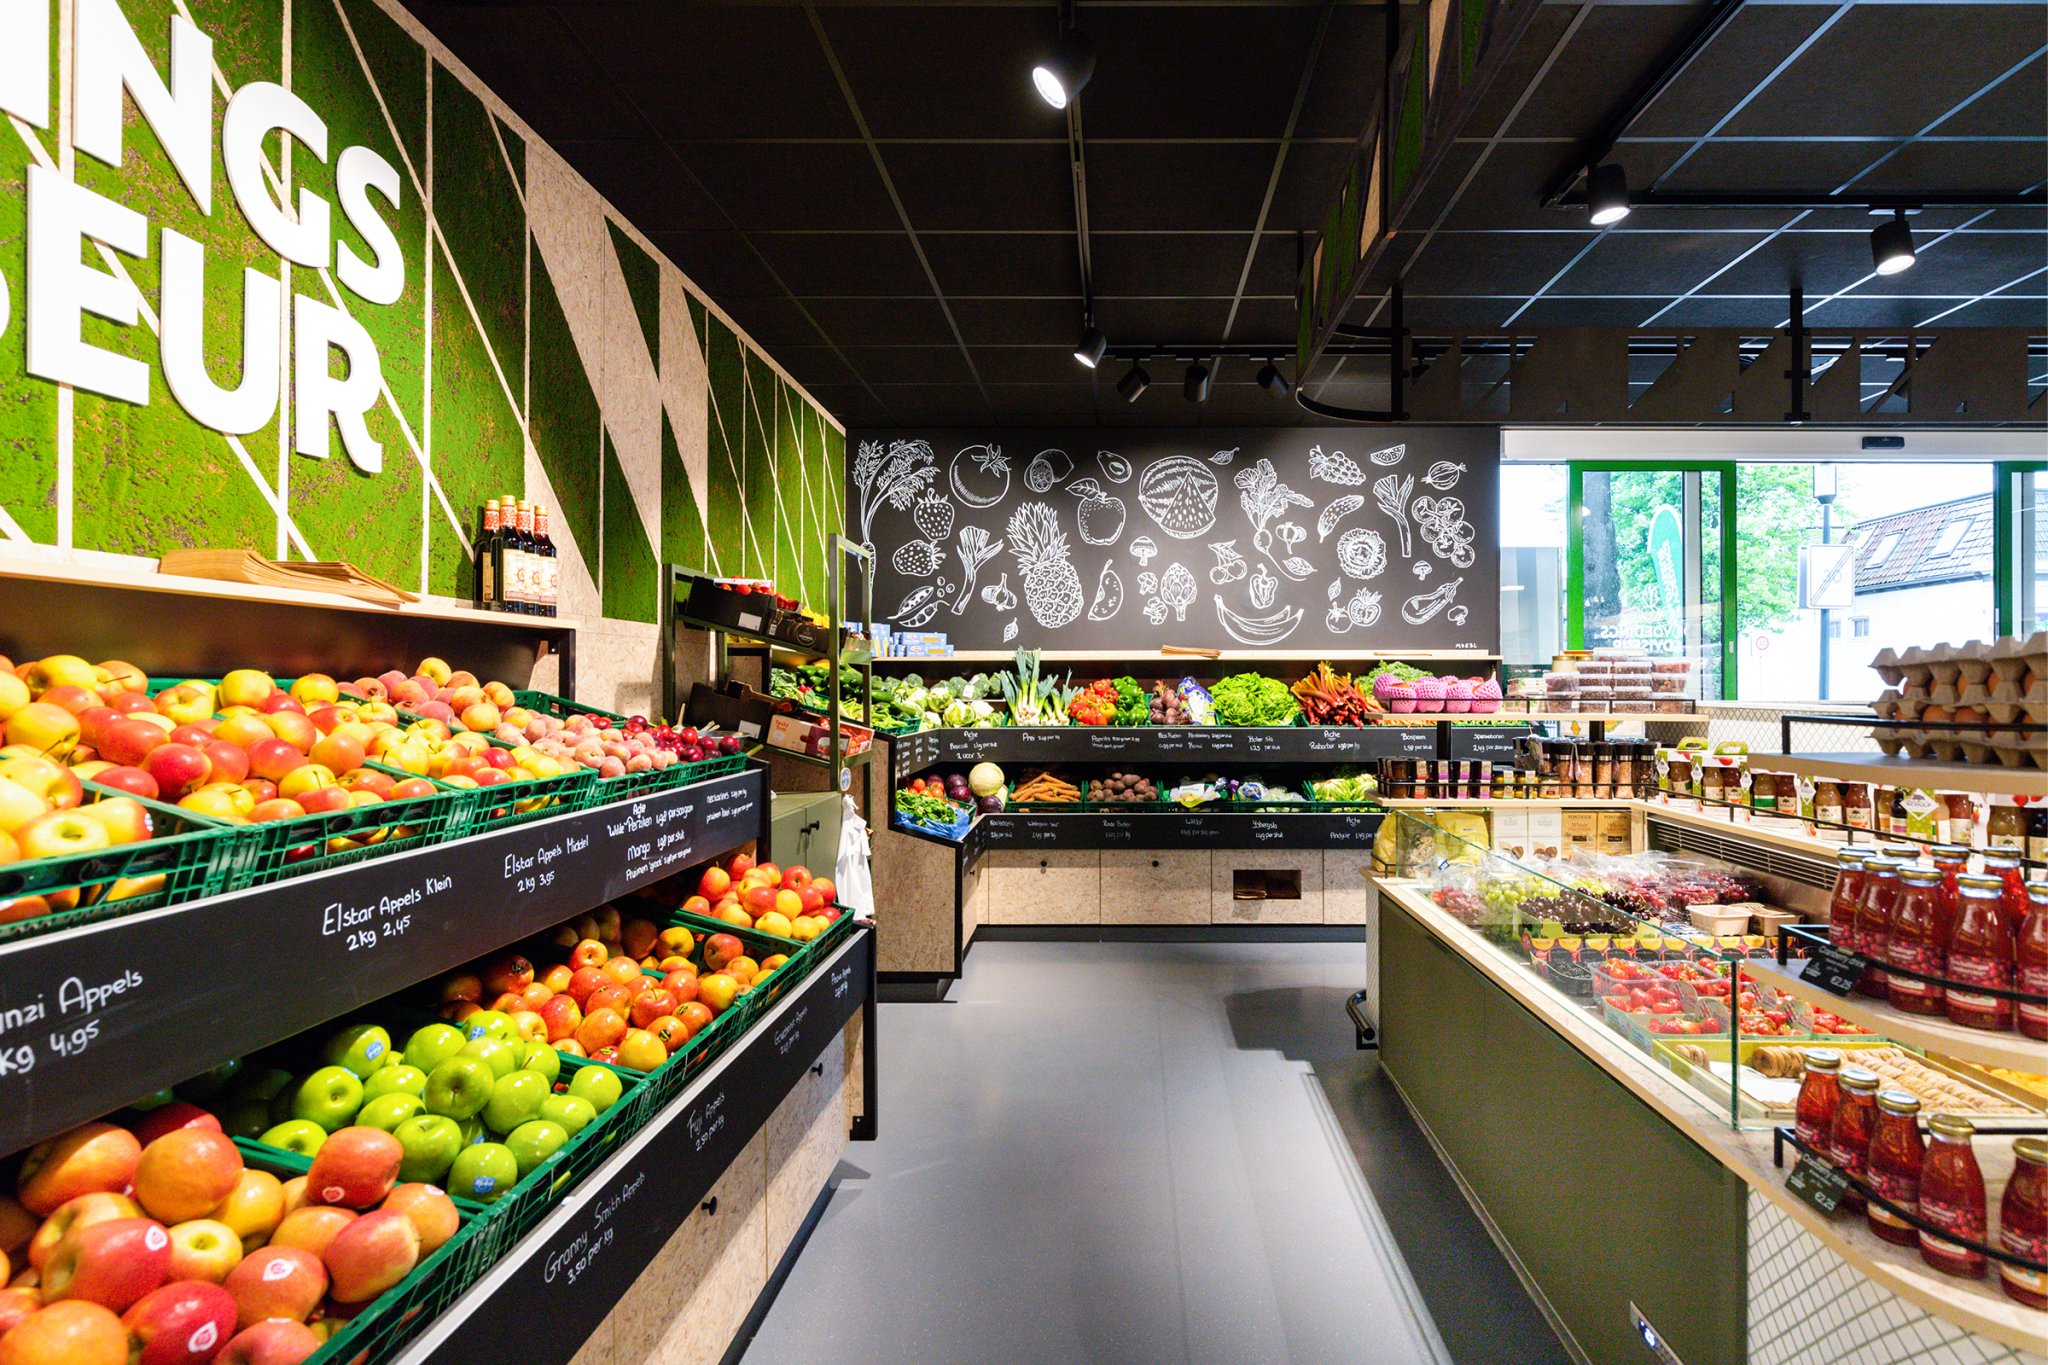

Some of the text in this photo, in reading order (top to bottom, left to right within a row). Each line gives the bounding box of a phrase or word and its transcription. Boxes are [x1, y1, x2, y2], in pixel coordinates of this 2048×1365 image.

[0, 164, 382, 474] EUR
[1022, 732, 1036, 742] Prei
[504, 834, 589, 879] Elstar Appels Middel
[627, 842, 651, 861] Mango
[322, 875, 453, 936] Elstar Appels Klein
[383, 914, 412, 937] 2,45
[58, 969, 144, 1015] Appels
[686, 1091, 726, 1140] Fuji Appels
[544, 1171, 646, 1284] Granny Smith Appels
[587, 1236, 603, 1267] per
[603, 1226, 614, 1247] kg
